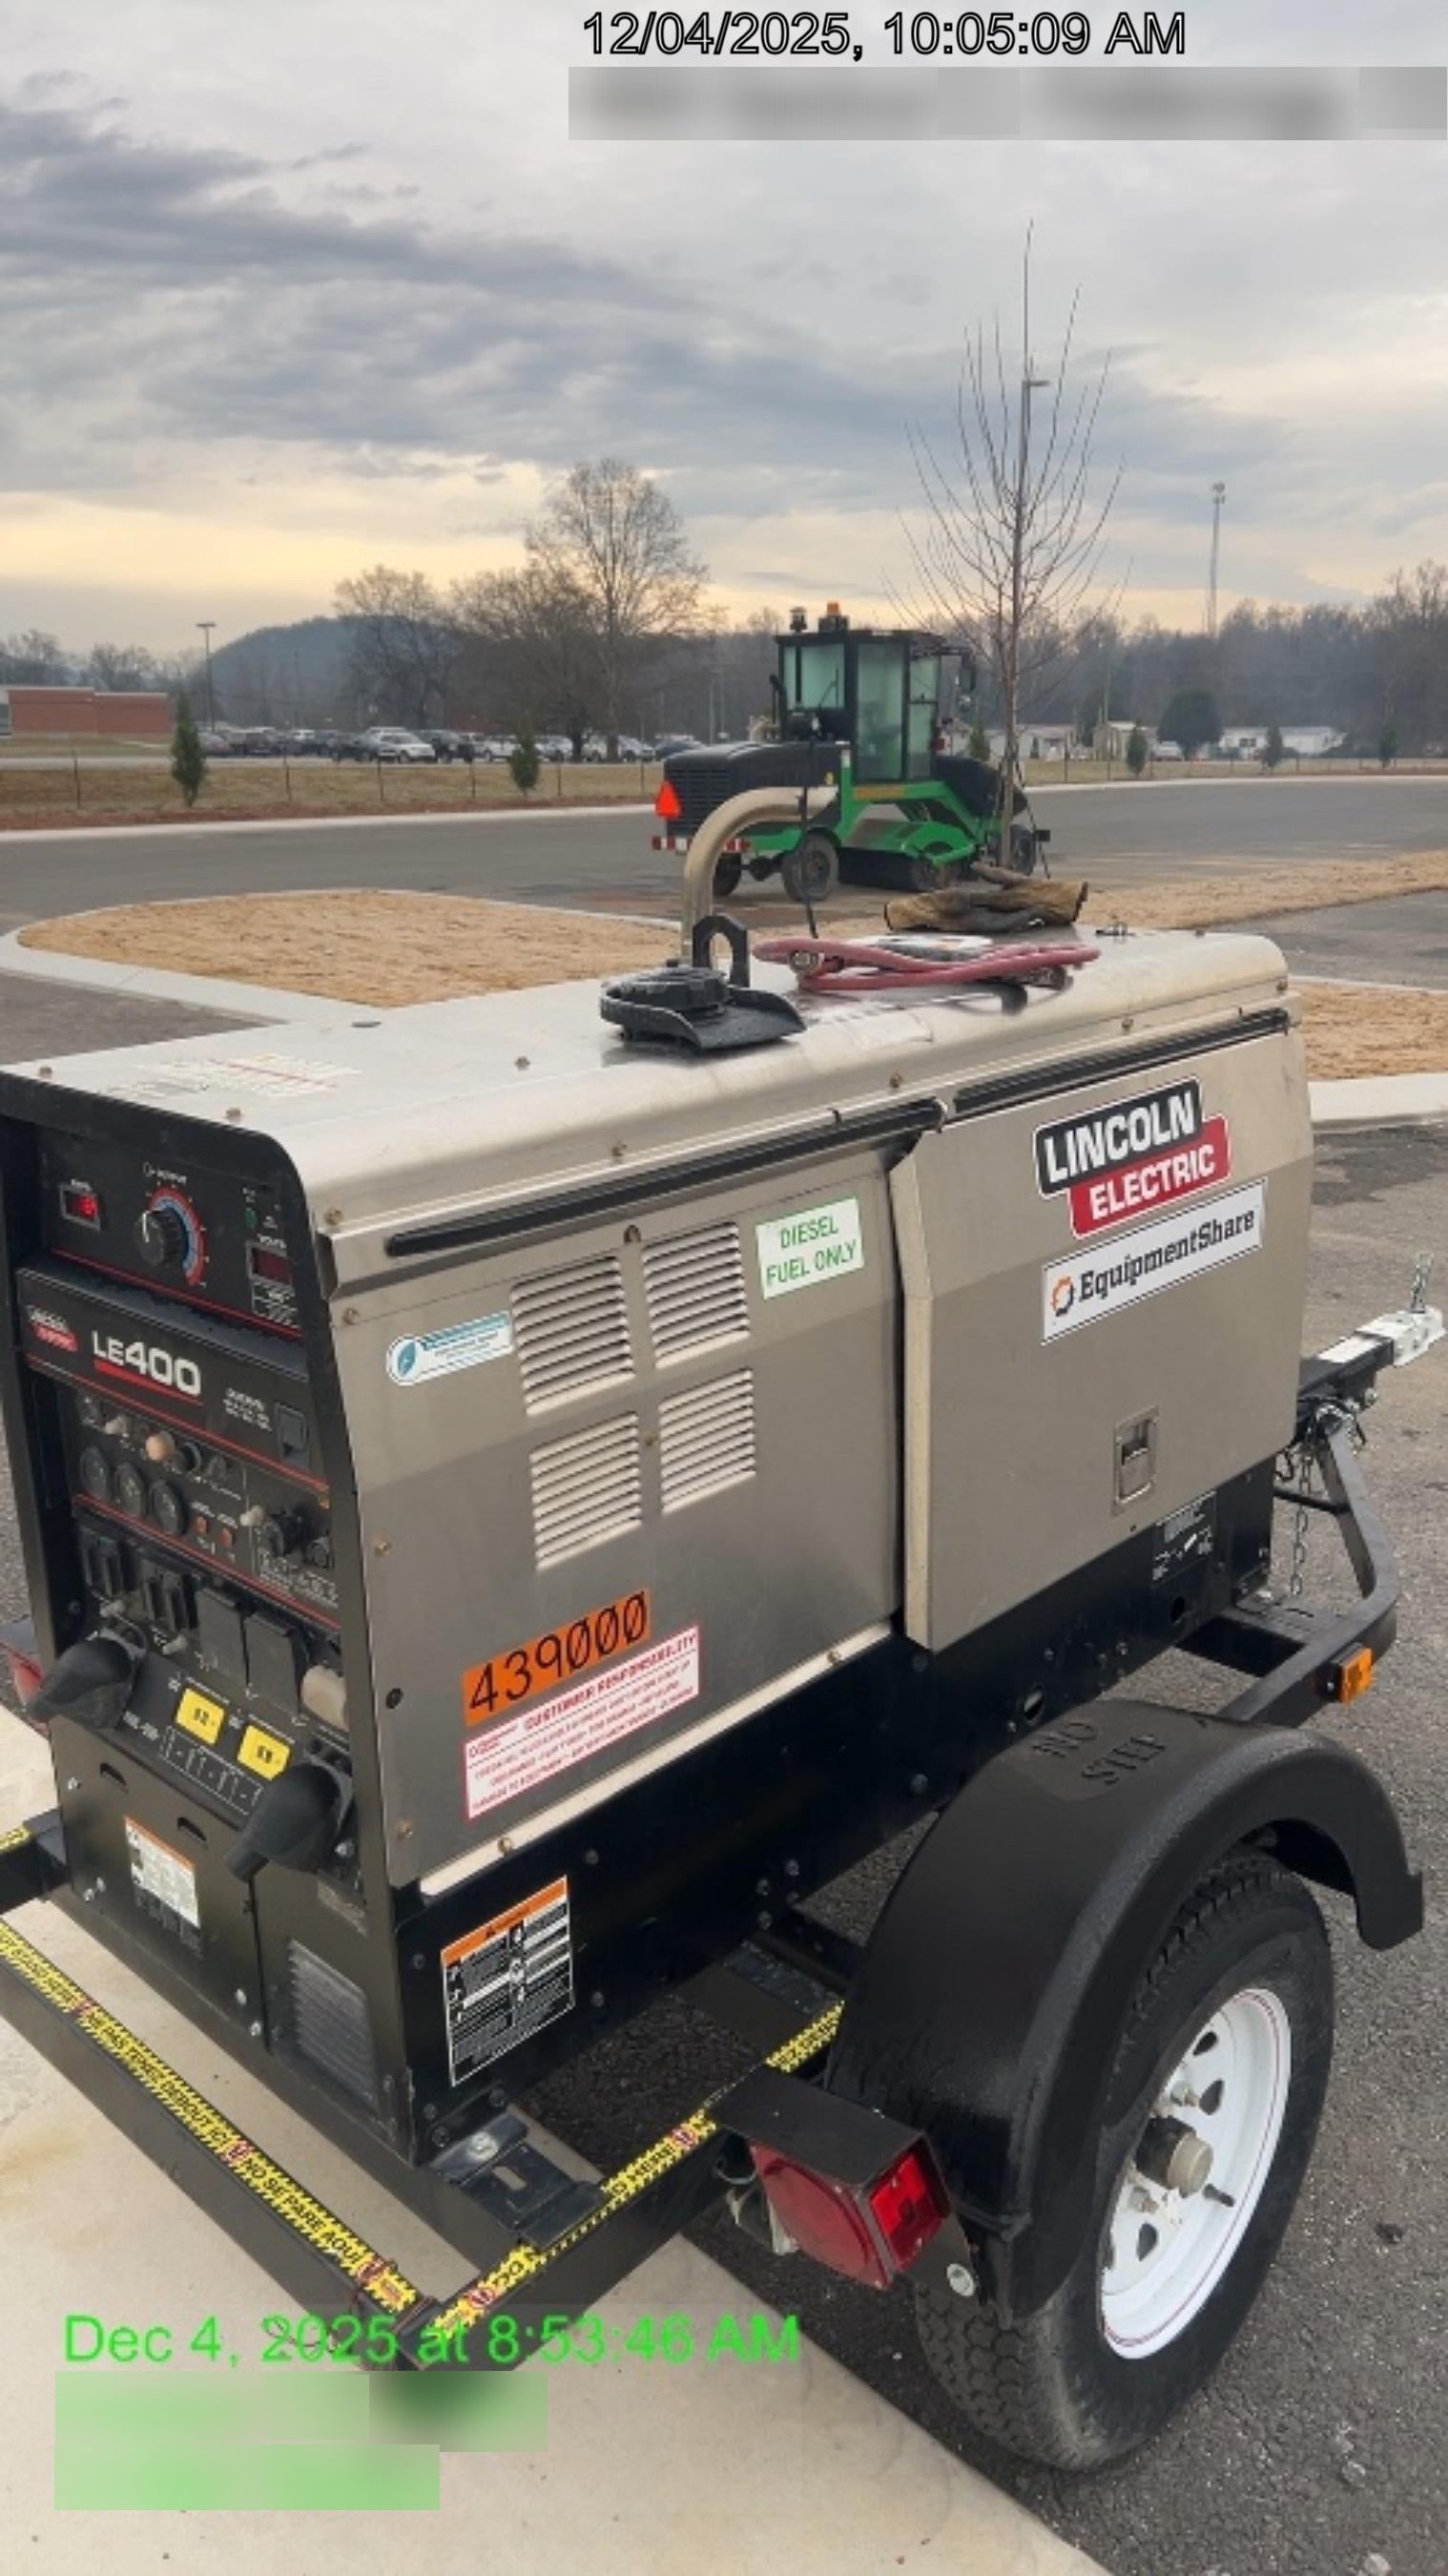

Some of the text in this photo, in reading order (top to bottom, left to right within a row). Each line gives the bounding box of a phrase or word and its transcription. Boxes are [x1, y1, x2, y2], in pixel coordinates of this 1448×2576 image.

[1045, 1091, 1196, 1184] LINCOLN
[1088, 1144, 1217, 1220] ELECTRIC
[767, 1239, 857, 1285] FUEL ONLY
[779, 1215, 839, 1249] DIESEL
[1079, 1209, 1255, 1302] EquipmentShare
[92, 1330, 201, 1397] LE400
[468, 1590, 648, 1713] 439000
[1032, 1721, 1099, 1758] NO
[1081, 1733, 1167, 1787] STEP
[240, 2155, 268, 2181] NO
